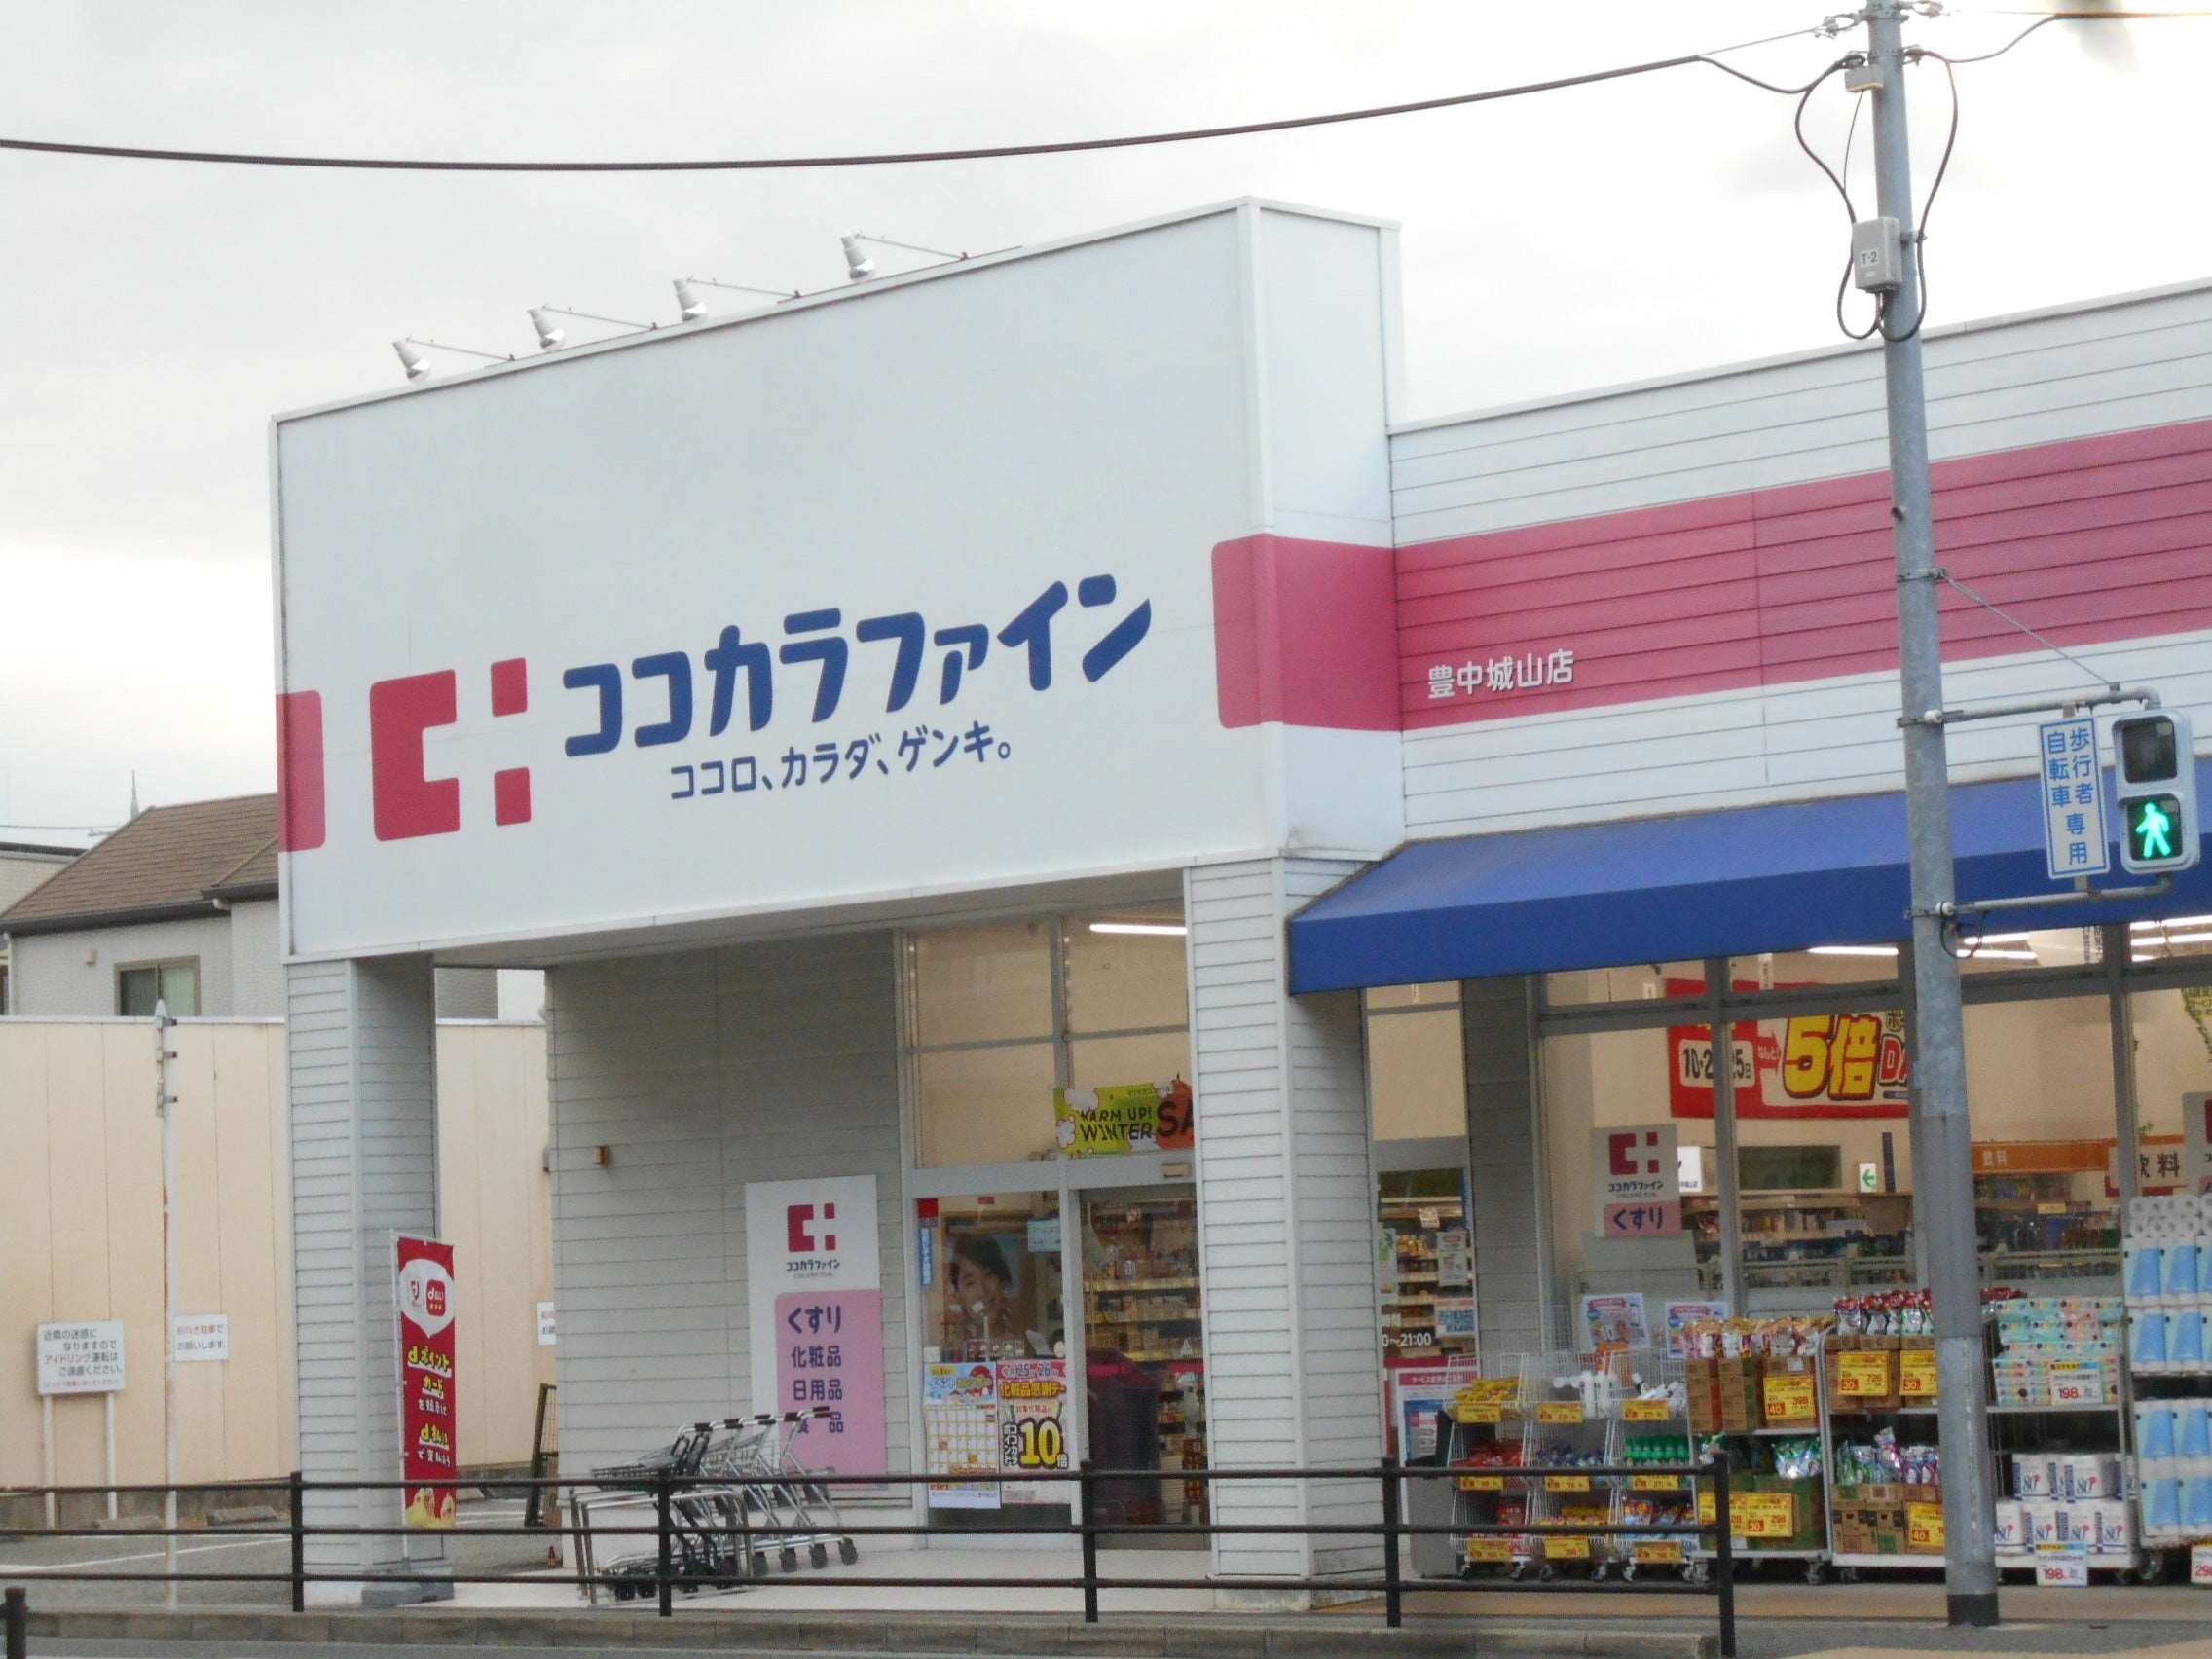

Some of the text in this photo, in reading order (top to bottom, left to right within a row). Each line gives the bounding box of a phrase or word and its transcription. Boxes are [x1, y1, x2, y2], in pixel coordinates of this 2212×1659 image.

[562, 572, 1152, 757] ココカラファイン
[1427, 648, 1574, 700] 豊中城山店
[2047, 730, 2072, 808] 自転車
[2069, 727, 2093, 805] 歩行者
[2065, 812, 2088, 866] 専用
[1784, 1014, 1881, 1100] 5倍
[1079, 1108, 1122, 1122] WARM
[1079, 1123, 1154, 1142] WINTER
[1607, 1180, 1664, 1193] ココカラファイン
[1612, 1206, 1663, 1231] くすり
[786, 1258, 841, 1272] ココカラファイン
[787, 1305, 842, 1334] くすり
[62, 1339, 117, 1351] なりますので
[791, 1346, 842, 1368] 化粧品
[793, 1379, 843, 1401] 日用品
